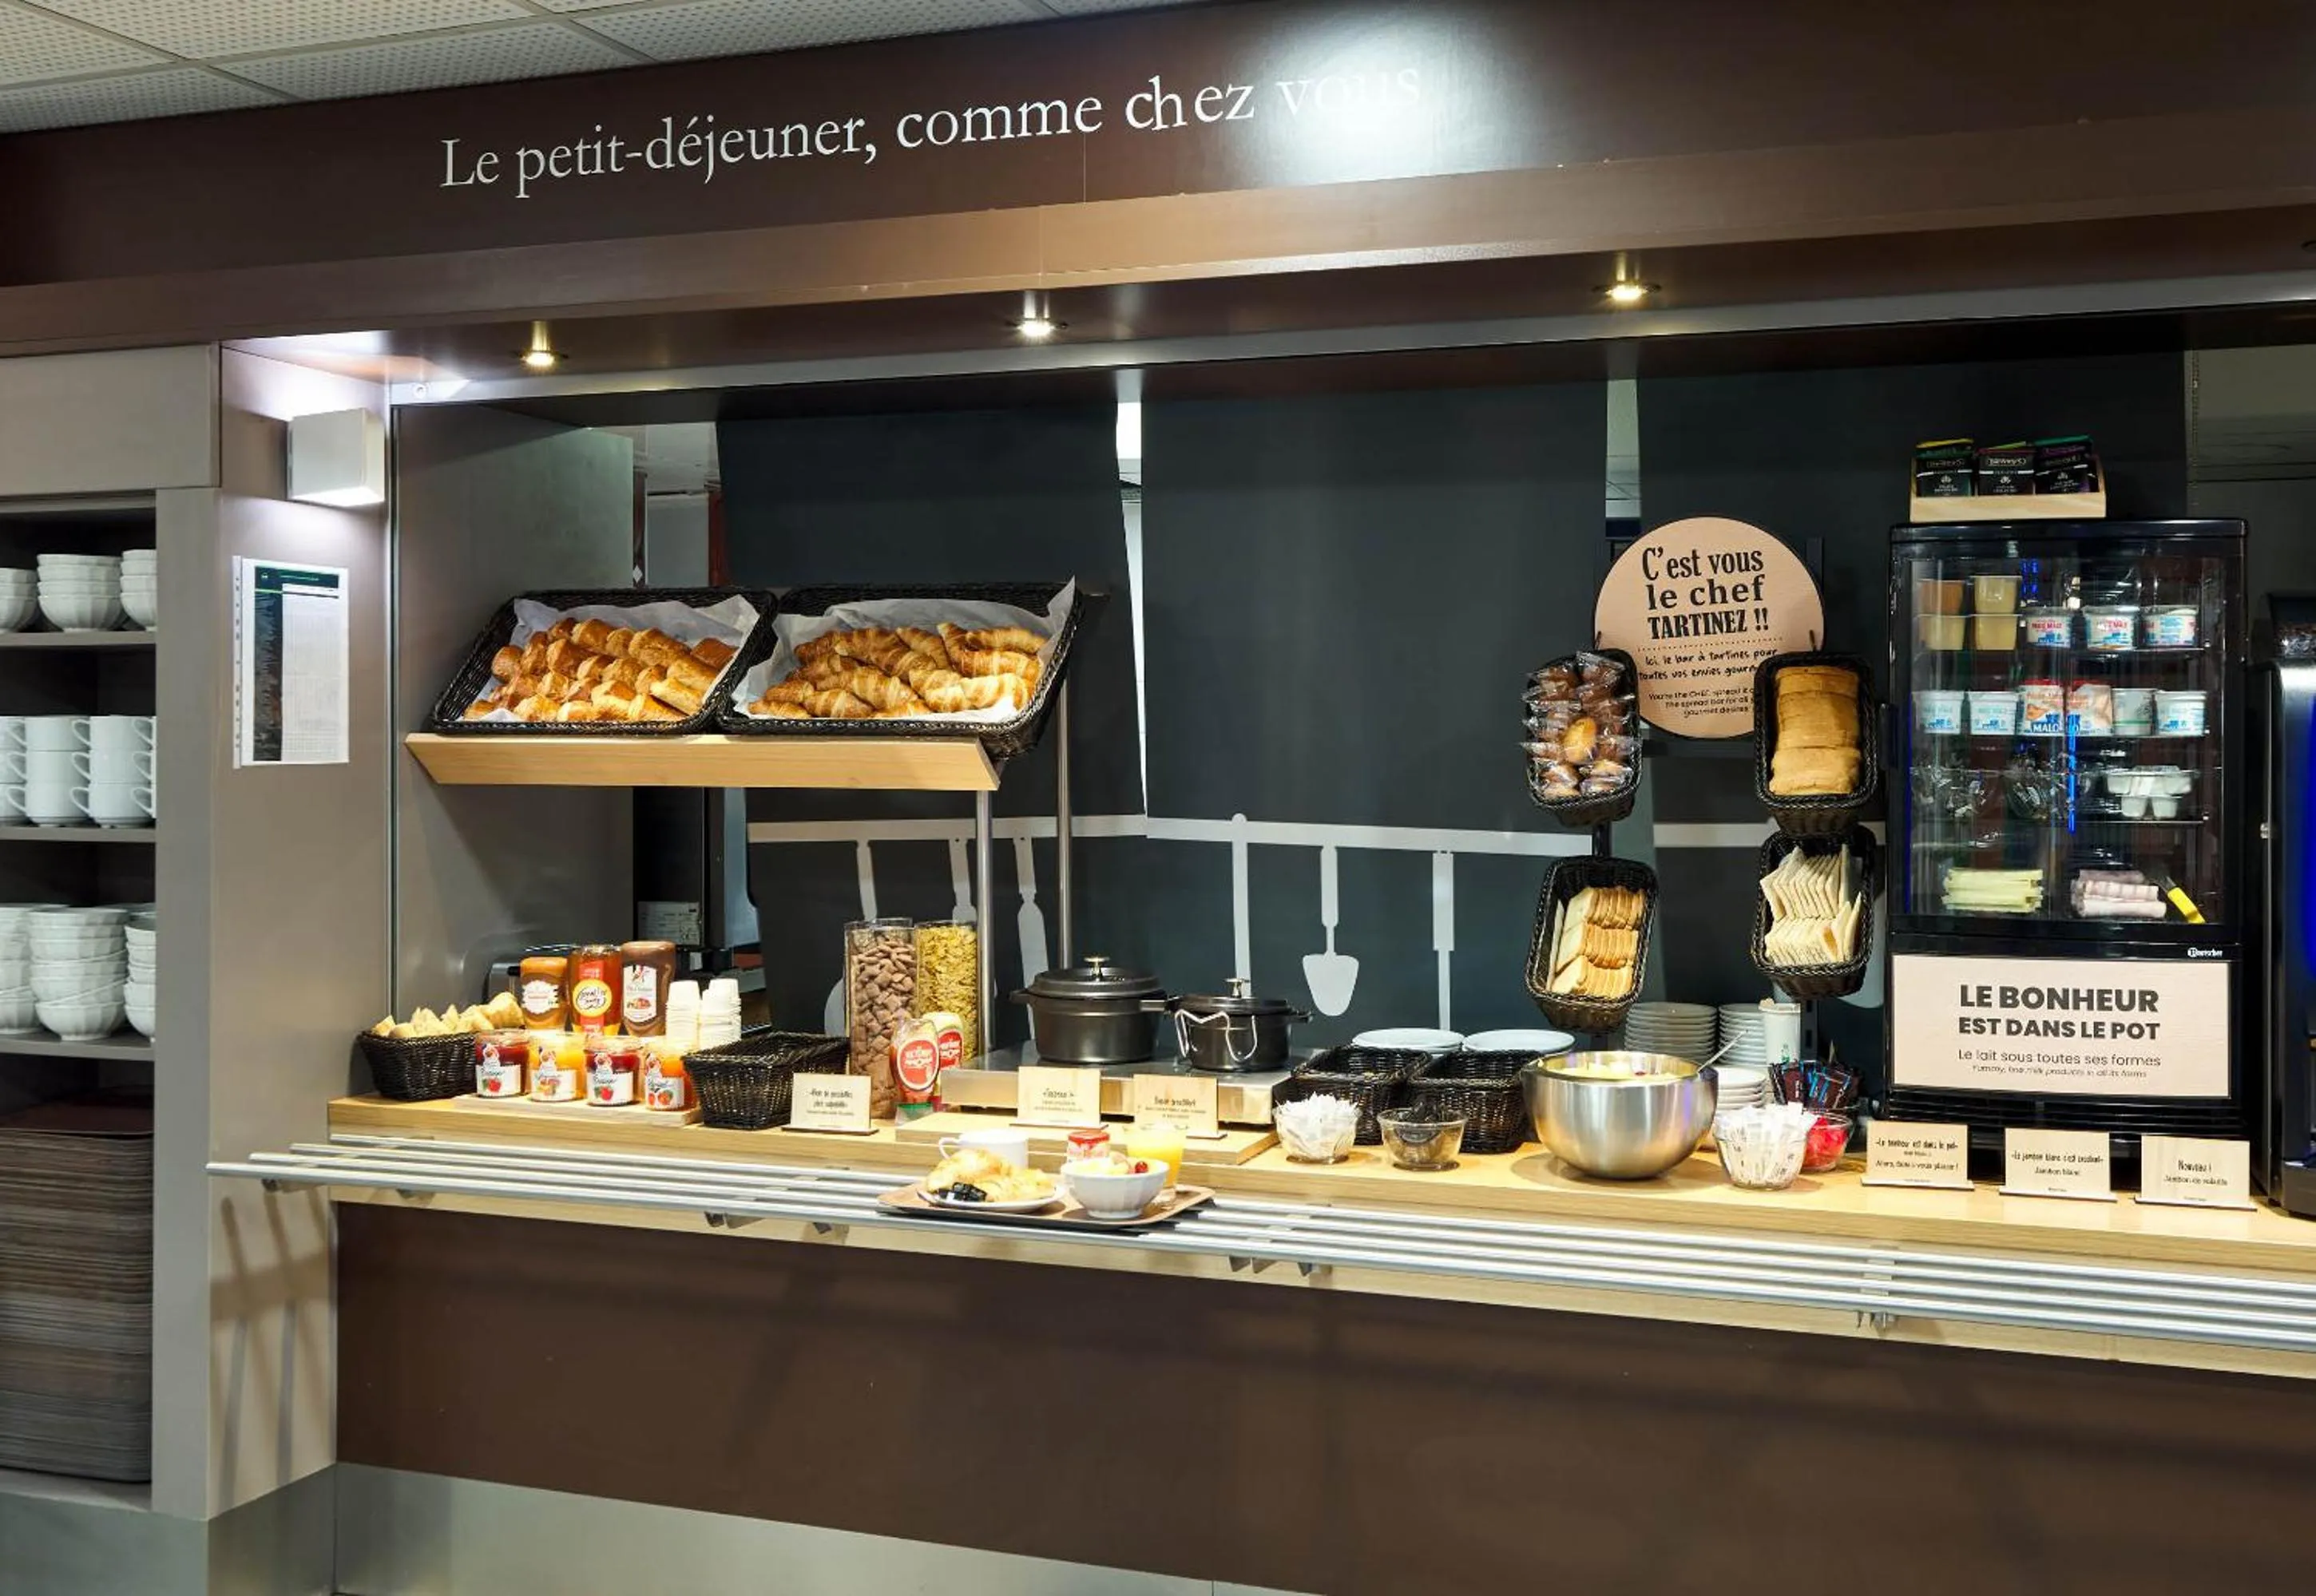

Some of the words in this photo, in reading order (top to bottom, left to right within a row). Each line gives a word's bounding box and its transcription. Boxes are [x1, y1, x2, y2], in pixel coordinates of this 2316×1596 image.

[440, 138, 500, 187] Le
[514, 114, 877, 199] petit-déjeuner,
[895, 96, 1103, 149] comme
[1124, 74, 1255, 132] chez
[1275, 67, 1422, 117] vous
[1642, 546, 1702, 581] C'est
[1707, 549, 1764, 574] vous
[1646, 584, 1678, 611] le
[1689, 573, 1766, 607] chef
[1647, 608, 1747, 640] TARTINEZ
[1754, 607, 1769, 632] !!
[1676, 654, 1693, 664] bar
[1698, 650, 1706, 661] à
[1708, 650, 1751, 661] tartines
[1753, 648, 1779, 661] pour
[1638, 671, 1668, 681] toutes
[1671, 670, 1687, 679] vos
[1691, 666, 1721, 677] envies
[1959, 984, 1993, 1008] LE
[1998, 985, 2159, 1013] BONHEUR
[1958, 1016, 2001, 1036] EST
[2006, 1018, 2076, 1039] DANS
[2080, 1021, 2106, 1039] LE
[2111, 1022, 2160, 1040] POT
[1958, 1049, 1973, 1060] Le
[1976, 1049, 1997, 1061] lait
[2001, 1052, 2033, 1063] sous
[2036, 1052, 2081, 1065] toutes
[2084, 1055, 2108, 1066] ses
[2111, 1053, 2162, 1067] formes
